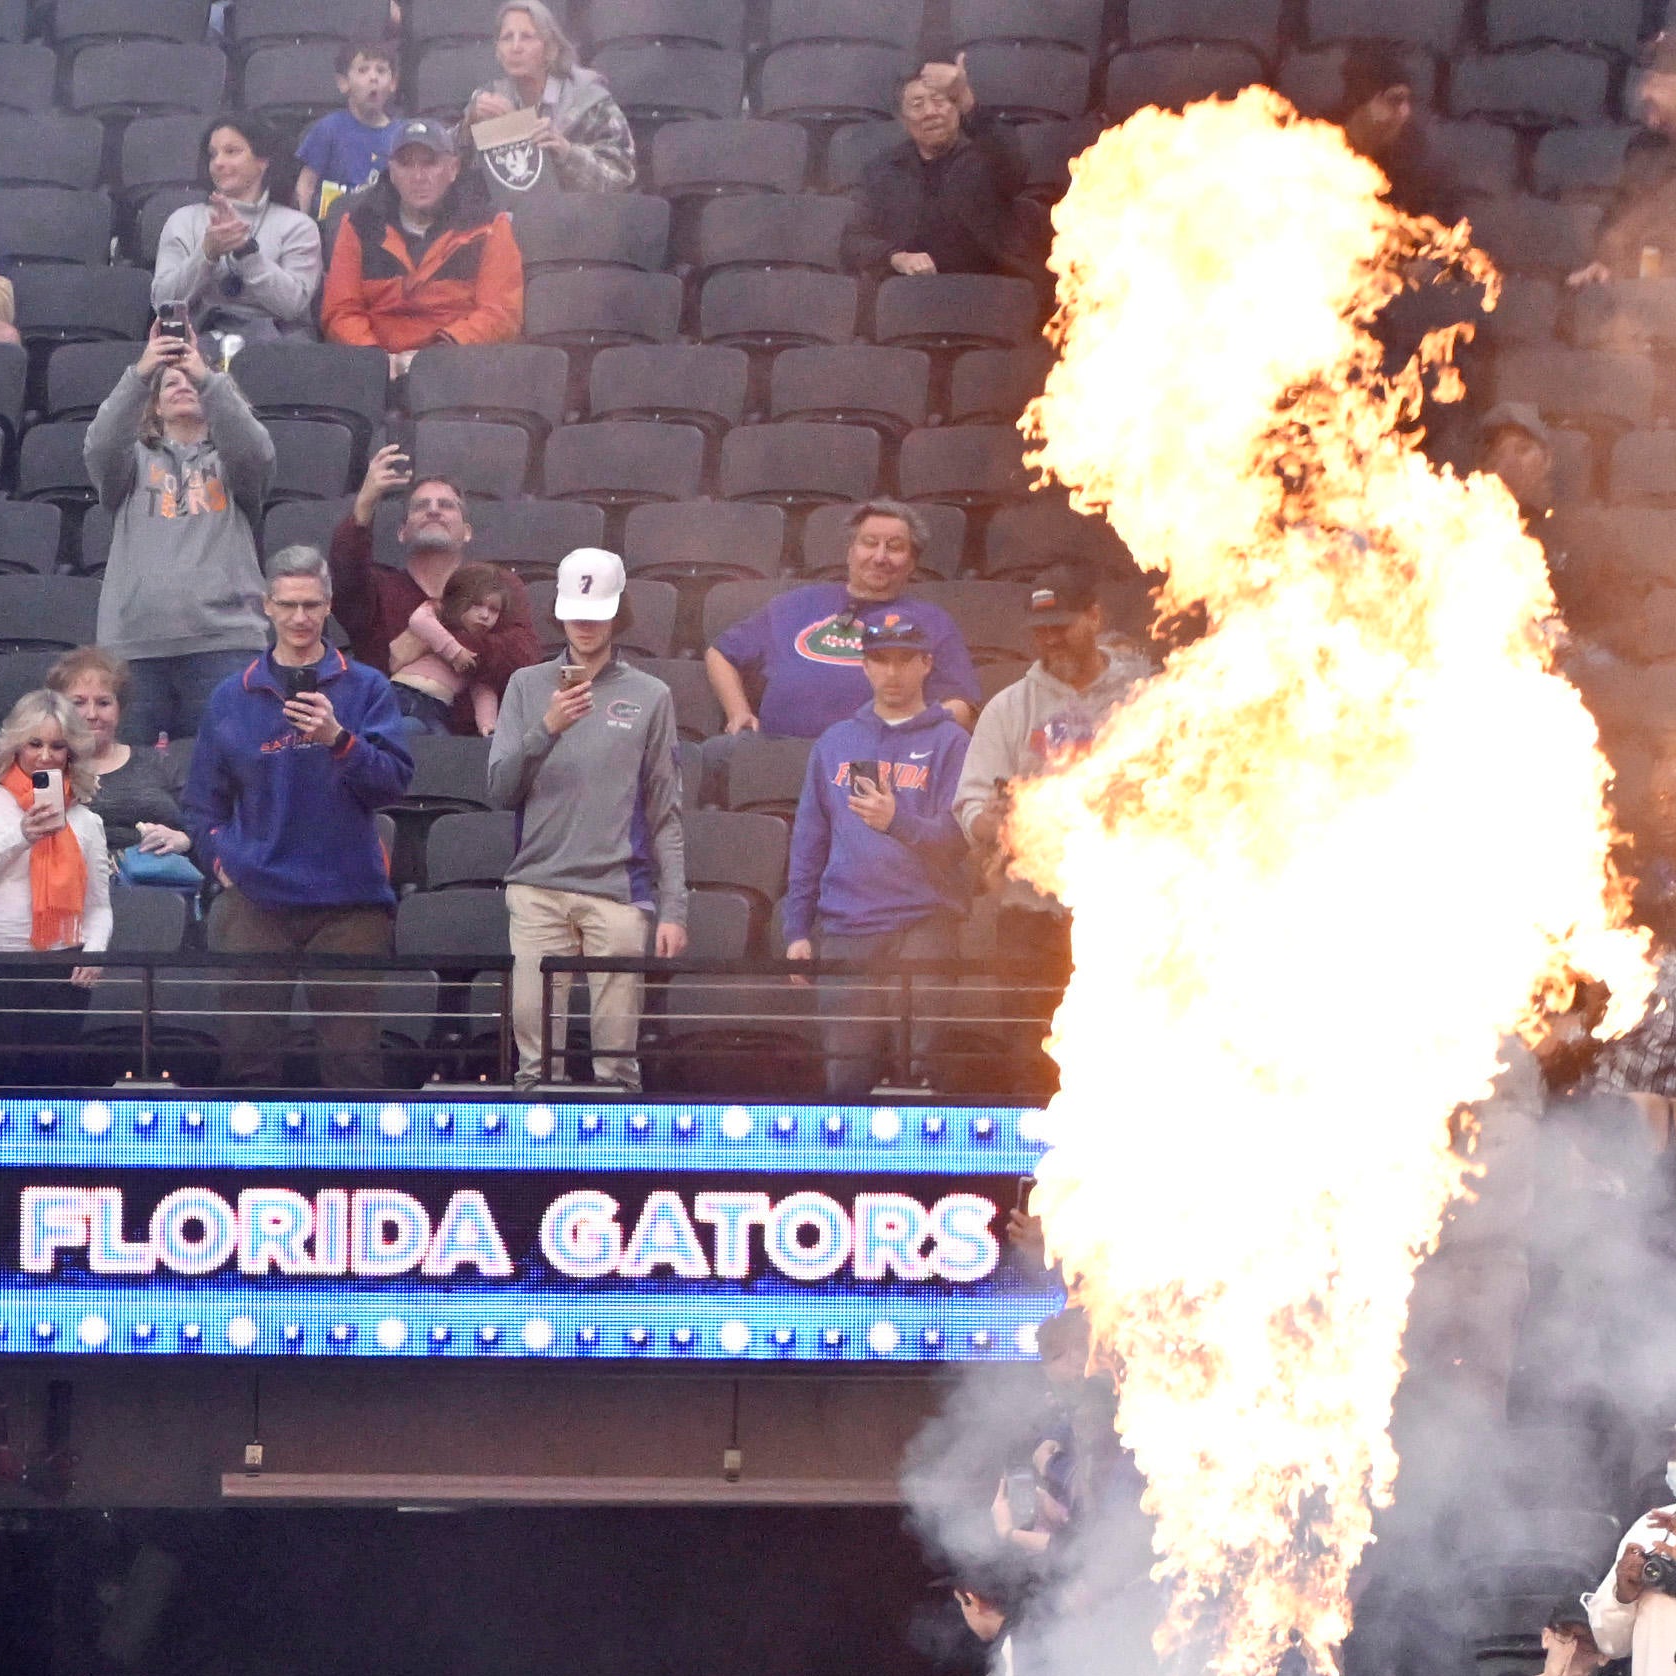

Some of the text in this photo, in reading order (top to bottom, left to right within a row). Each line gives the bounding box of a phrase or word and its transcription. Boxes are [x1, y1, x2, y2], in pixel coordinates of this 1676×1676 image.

[580, 575, 594, 595] 7
[20, 1186, 1001, 1282] FLORIDA GATORS
